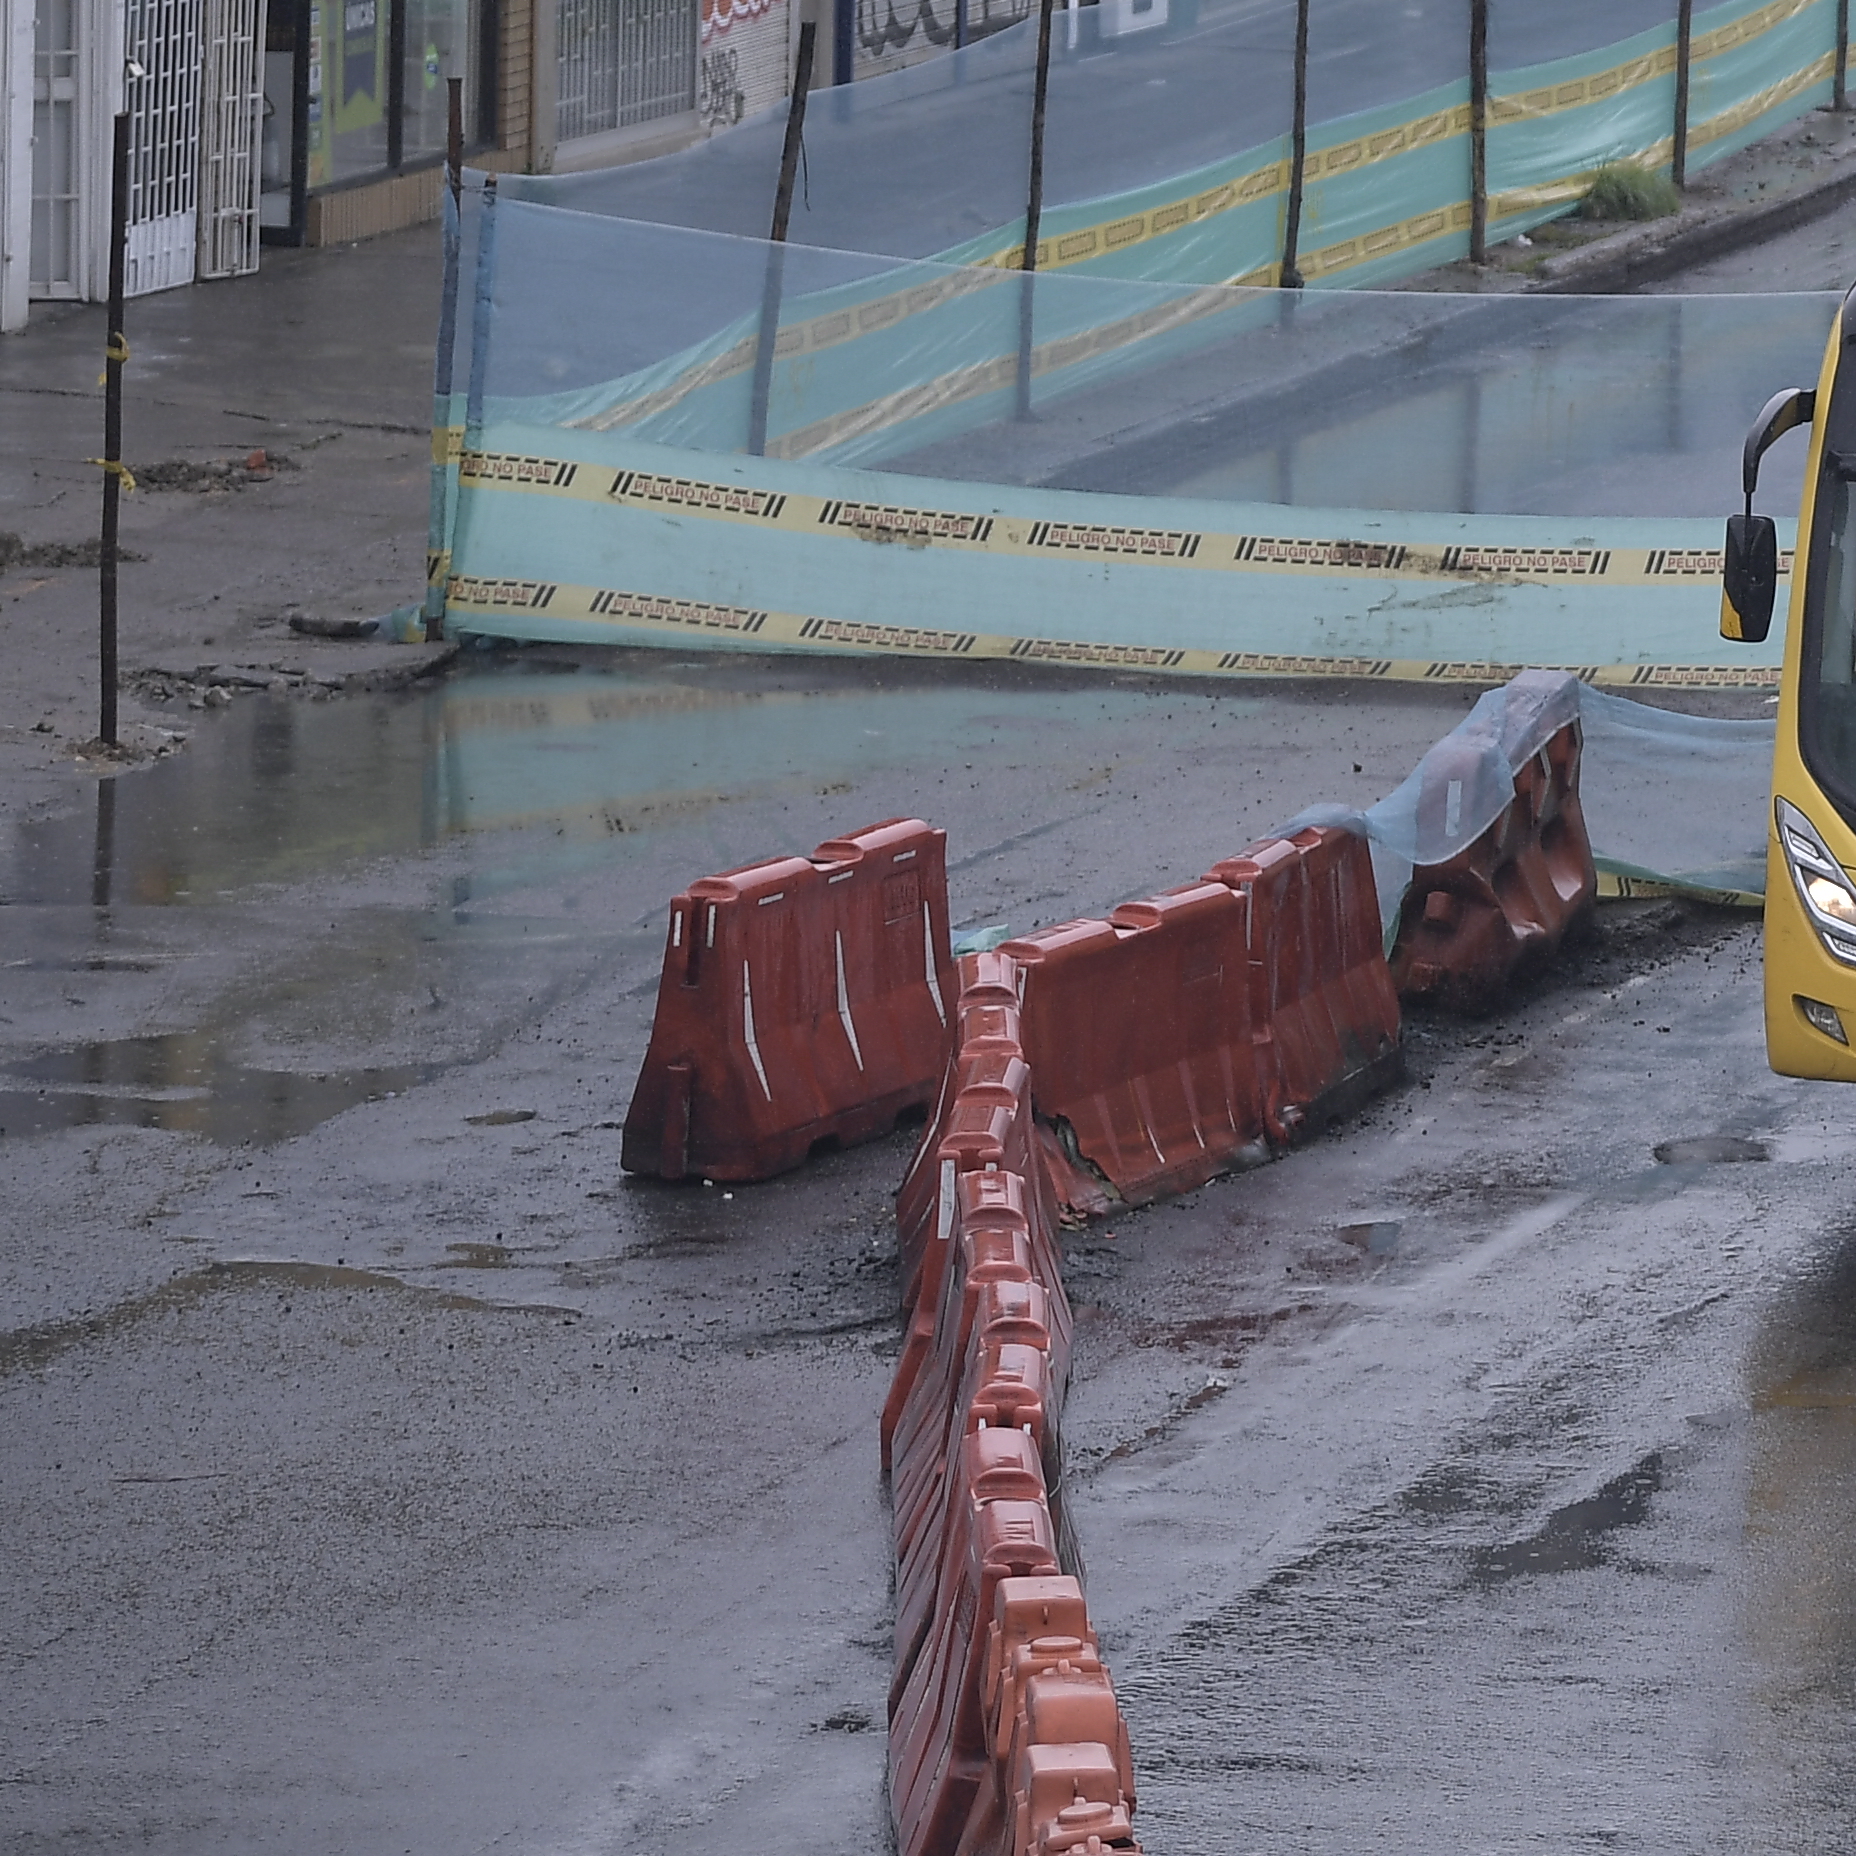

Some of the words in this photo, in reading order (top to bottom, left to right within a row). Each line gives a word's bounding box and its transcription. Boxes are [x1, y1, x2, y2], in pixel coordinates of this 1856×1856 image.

[492, 459, 513, 474] NO
[517, 463, 553, 478] PASE
[634, 479, 695, 500] PELIGRO
[699, 488, 720, 503] NO
[724, 494, 760, 510] PASE
[843, 508, 905, 528] PELIGRO
[908, 516, 929, 531] NO
[933, 518, 970, 534] PASE
[1050, 530, 1112, 546] PELIGRO
[1115, 535, 1137, 549] NO
[1140, 537, 1176, 551] PASE
[1258, 544, 1319, 560] PELIGRO
[1323, 548, 1344, 561] NO
[1463, 553, 1523, 568] PELIGRO
[1526, 555, 1548, 568] NO
[1551, 556, 1586, 569] PASE
[614, 598, 675, 617] PELIGRO
[678, 606, 700, 620] NO
[705, 609, 741, 625] PASE
[824, 624, 886, 641] PELIGRO
[914, 633, 951, 647] PASE
[1654, 671, 1716, 683] PELIGRO
[1718, 673, 1739, 684] NO
